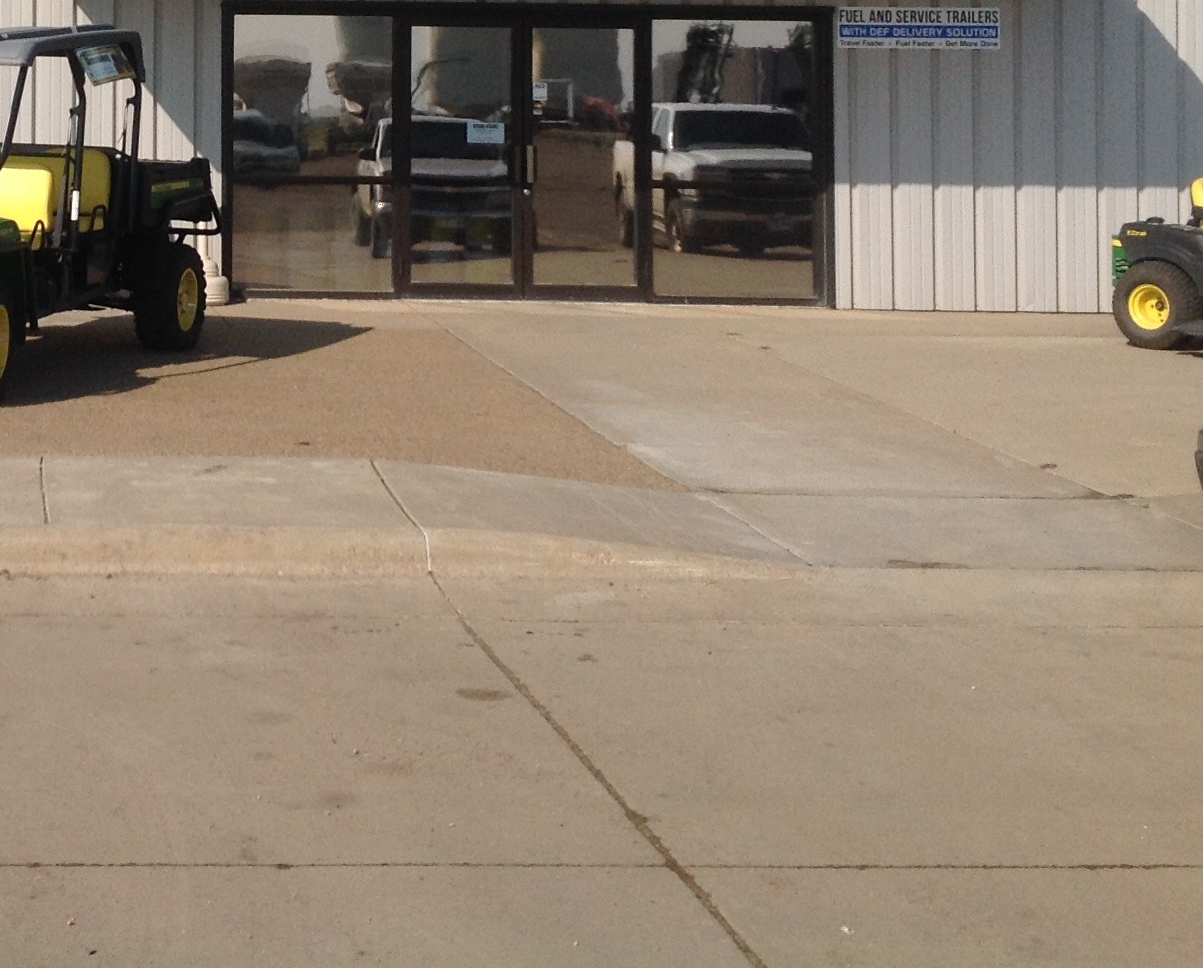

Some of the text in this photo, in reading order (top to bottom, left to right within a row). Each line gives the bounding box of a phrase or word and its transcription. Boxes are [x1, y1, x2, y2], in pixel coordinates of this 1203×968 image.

[839, 9, 998, 23] FUEL AND SERVICE TRAILERS
[842, 27, 996, 38] WITH DEF DELIVERY SOLUTION
